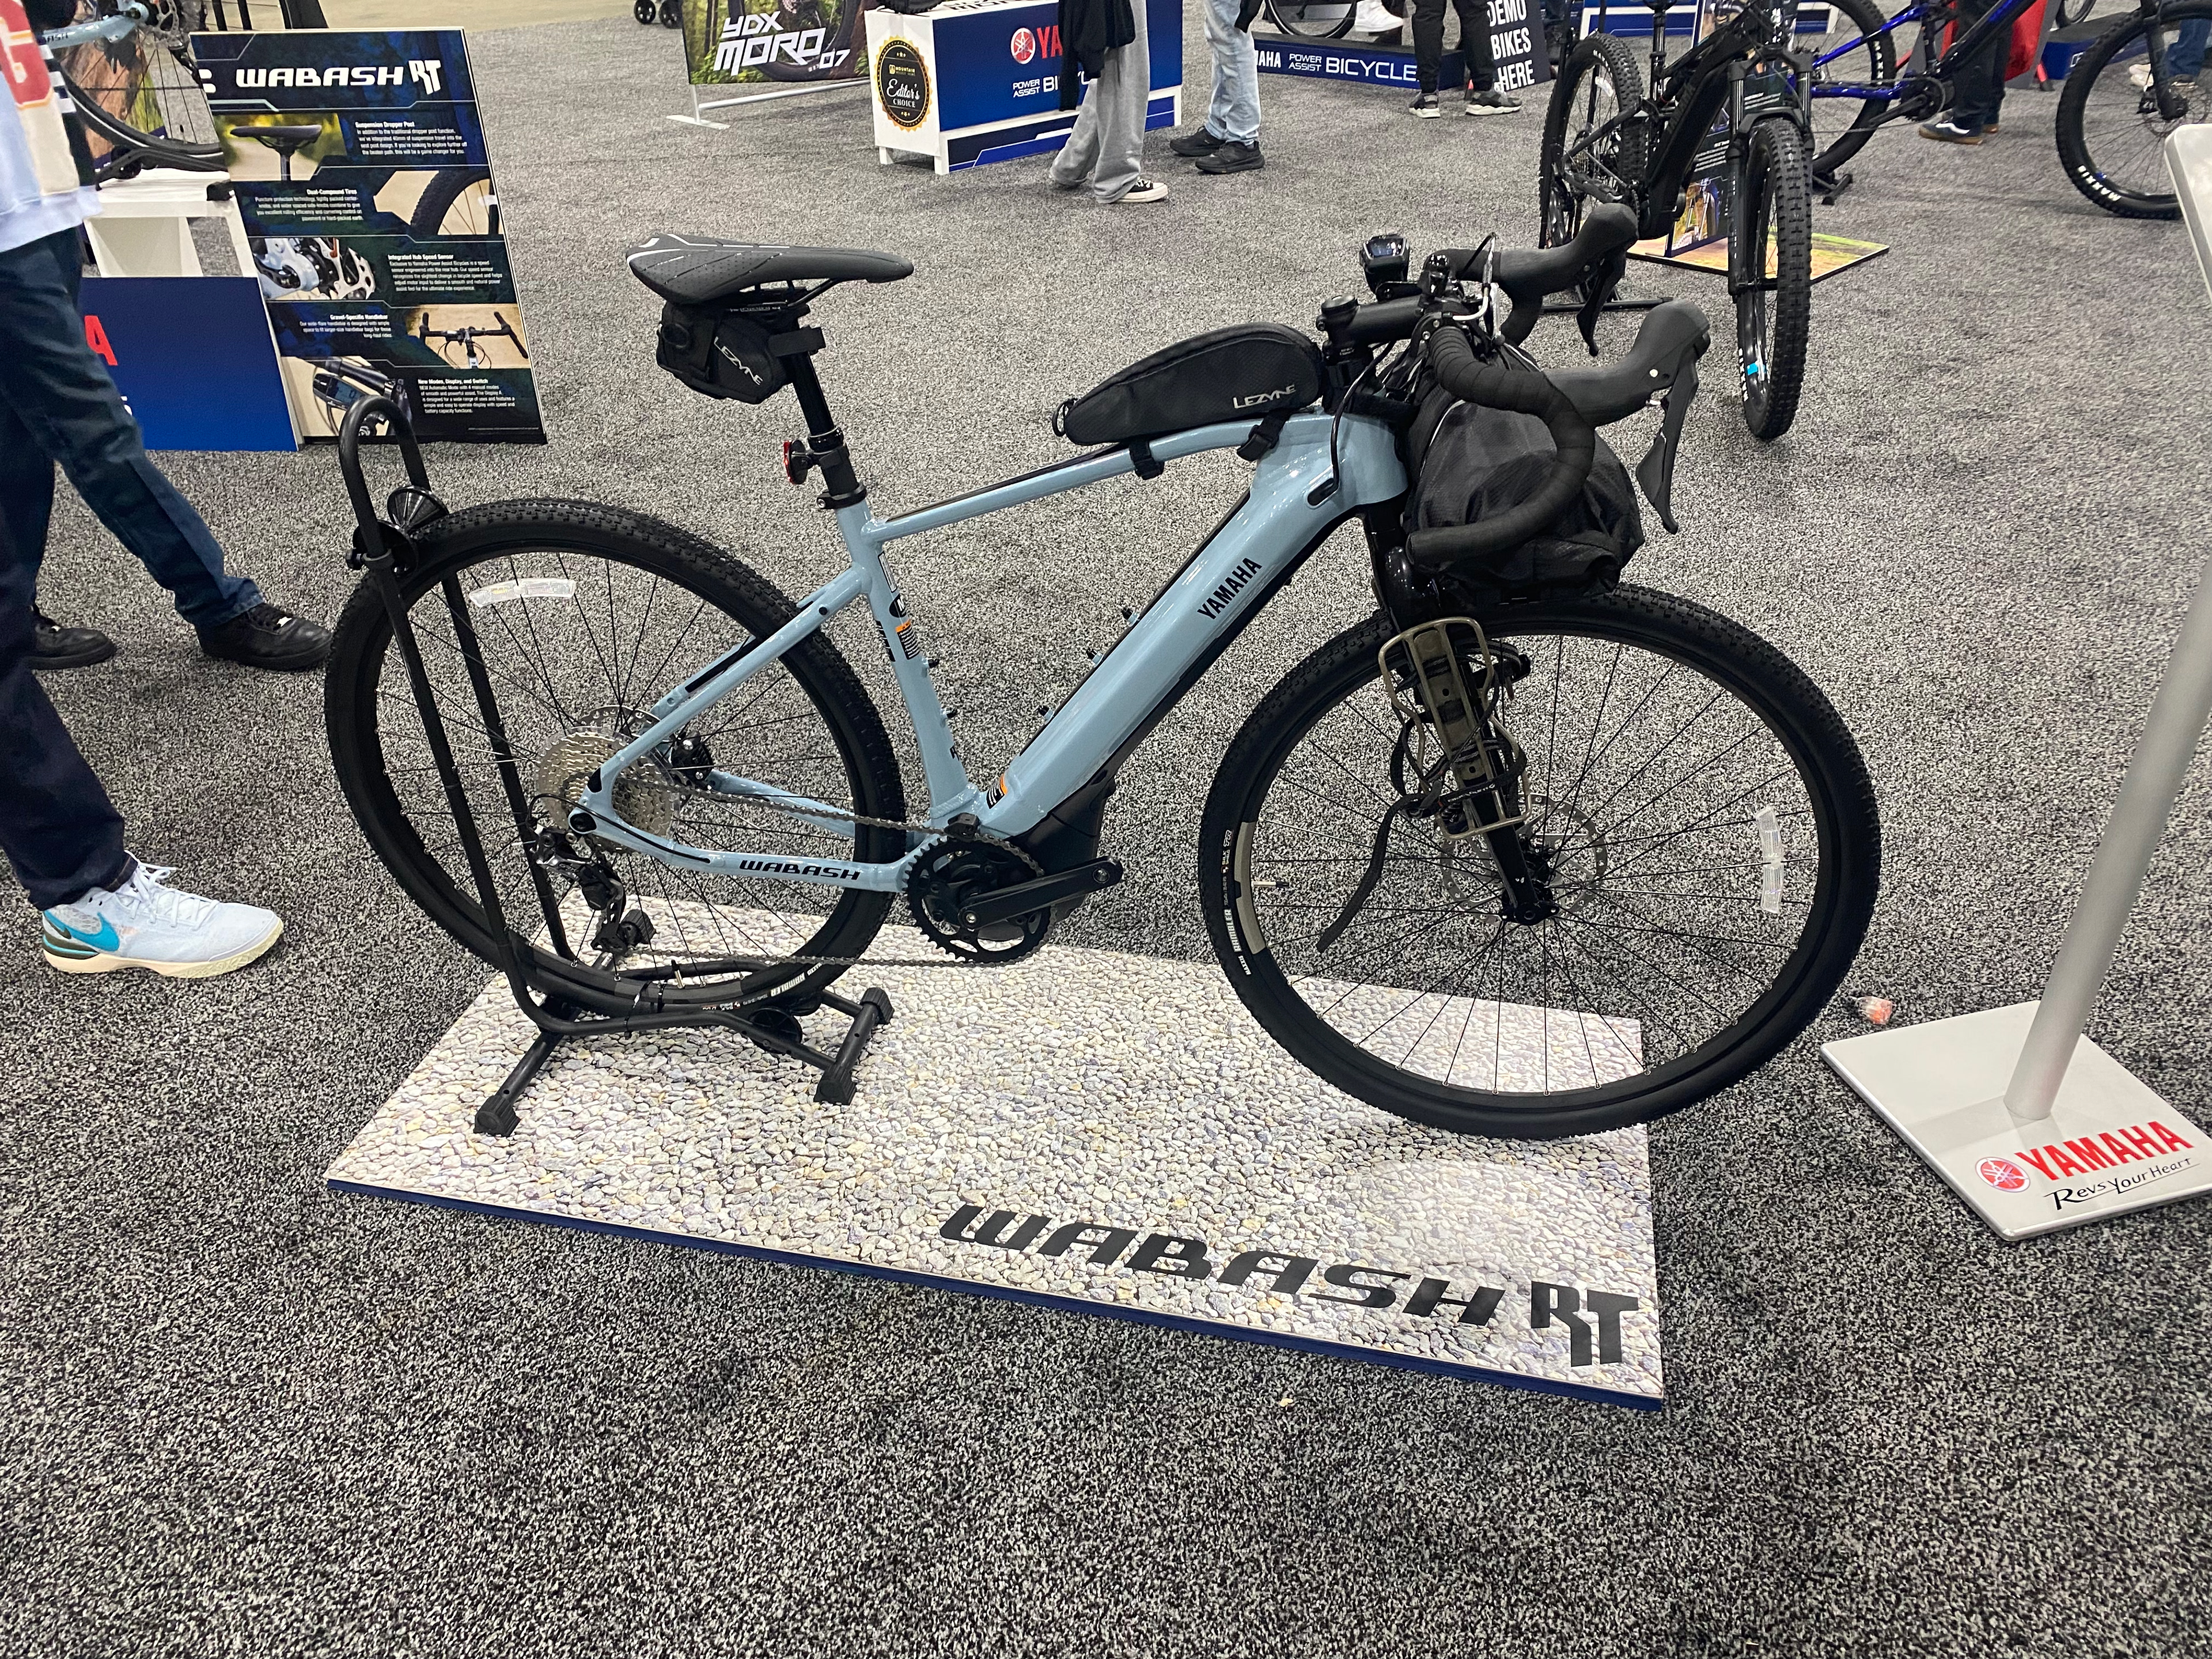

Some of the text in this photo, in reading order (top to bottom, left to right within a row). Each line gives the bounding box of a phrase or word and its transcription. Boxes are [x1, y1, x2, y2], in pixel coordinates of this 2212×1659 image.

[720, 11, 783, 38] YDX
[1490, 27, 1532, 60] BIKES
[819, 49, 851, 69] 07
[1288, 62, 1321, 72] ASSIST
[1289, 53, 1321, 63] POWER
[1326, 57, 1419, 81] BICYCLE
[236, 66, 403, 87] WABASH
[408, 60, 441, 94] RT
[1013, 79, 1040, 90] POWER
[1498, 59, 1535, 90] HERE
[887, 78, 920, 100] Editor's
[1013, 86, 1040, 98] ASSIST
[893, 98, 916, 108] CHOICE
[714, 336, 763, 385] LEZYNE
[1233, 384, 1296, 408] LEZYNE
[1196, 558, 1262, 619] YAMAHA
[740, 860, 860, 880] WABASH
[1224, 908, 1243, 952] RAMBLER
[1238, 955, 1252, 975] MAXXIS
[770, 972, 806, 997] RAMBLER
[2014, 1121, 2195, 1180] YAMAHA
[2044, 1158, 2192, 1210] Revs Your Heart
[939, 1205, 1638, 1367] WABASH RT
